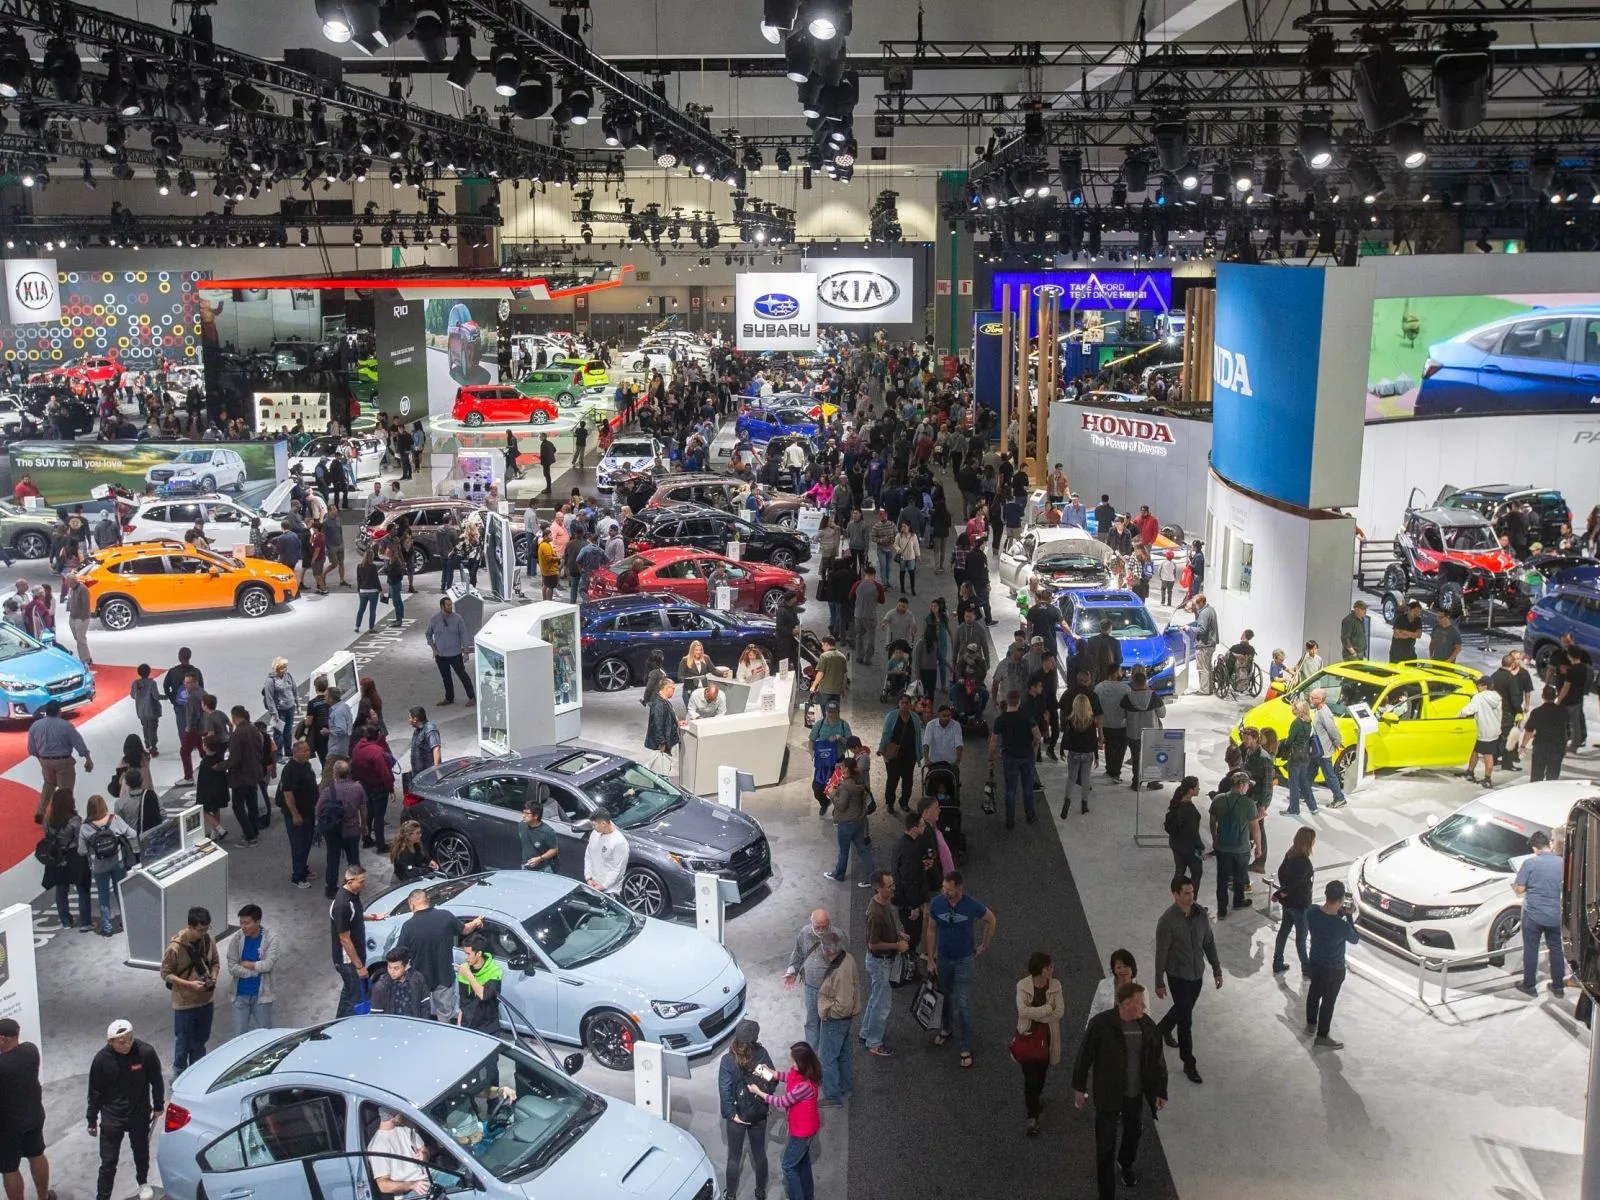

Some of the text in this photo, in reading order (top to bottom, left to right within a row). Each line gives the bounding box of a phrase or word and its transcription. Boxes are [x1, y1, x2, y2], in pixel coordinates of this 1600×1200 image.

[24, 281, 48, 301] KIA
[831, 280, 882, 303] KIA
[1070, 283, 1092, 291] TAKE
[1102, 283, 1125, 291] FORD
[1070, 291, 1092, 299] TEST
[393, 305, 409, 318] RIO
[743, 323, 811, 337] SUBARU
[1081, 412, 1176, 445] HONDA
[1091, 434, 1104, 447] The
[1105, 437, 1128, 451] Power
[1138, 441, 1167, 457] Dreams
[16, 459, 33, 467] The
[35, 459, 55, 467] SUV
[57, 459, 70, 467] for
[72, 459, 82, 467] all
[85, 460, 101, 469] you
